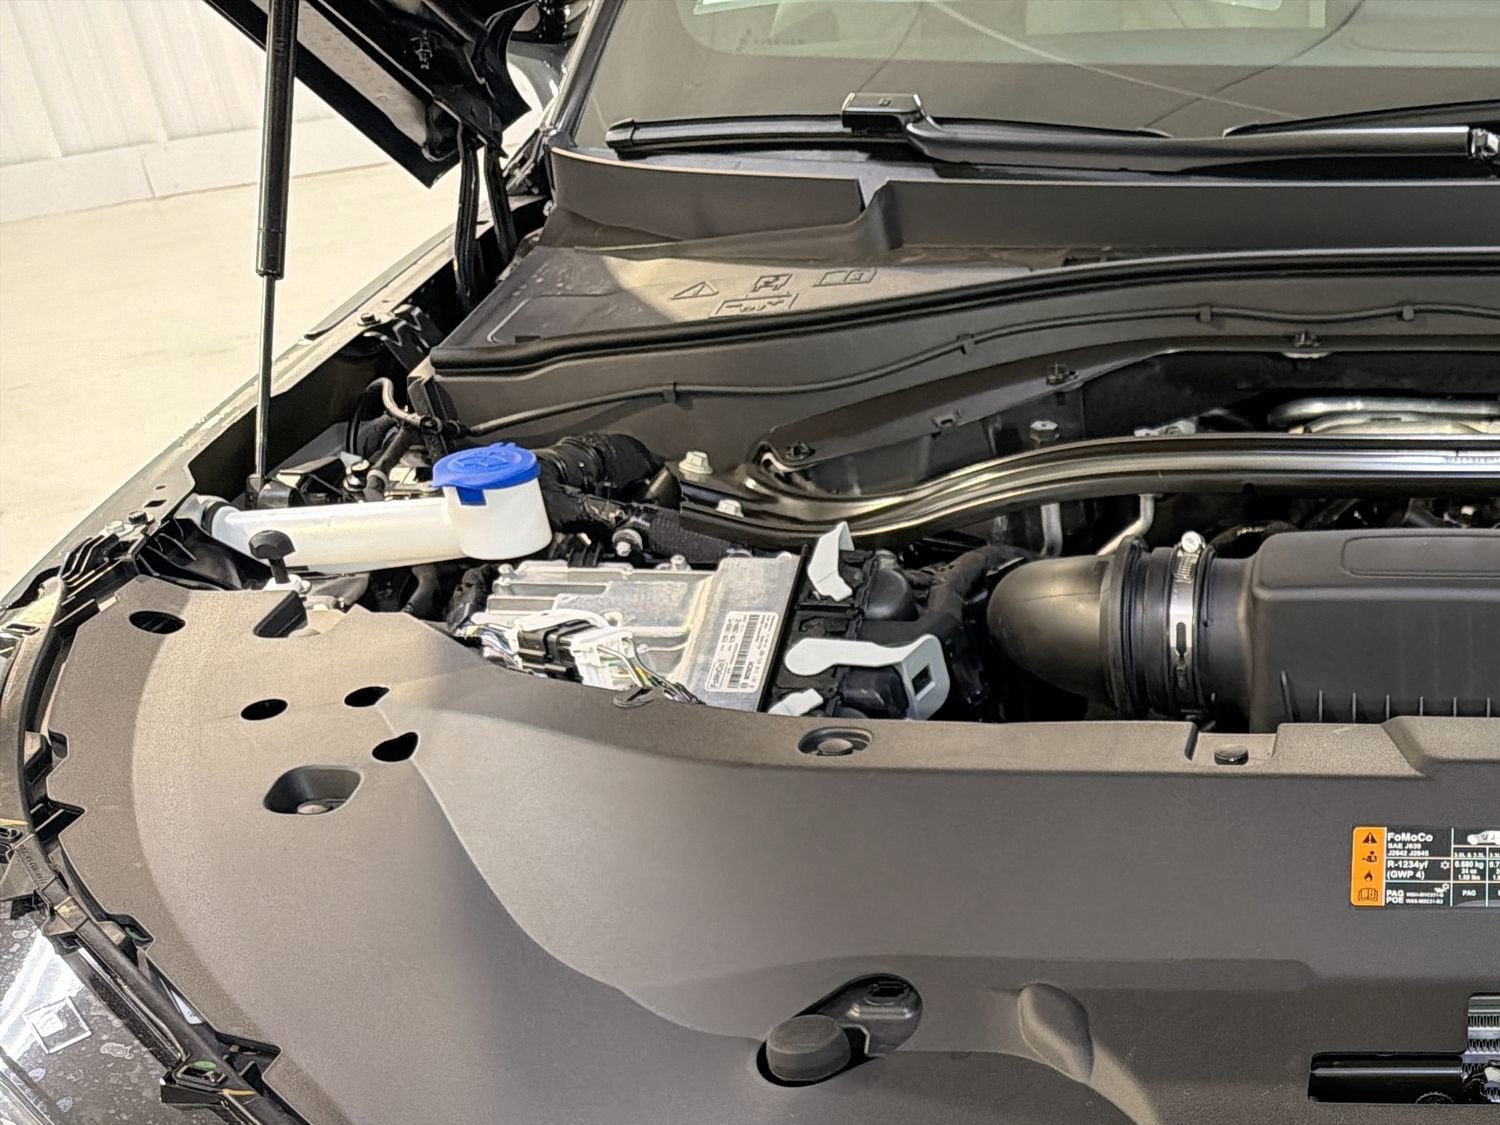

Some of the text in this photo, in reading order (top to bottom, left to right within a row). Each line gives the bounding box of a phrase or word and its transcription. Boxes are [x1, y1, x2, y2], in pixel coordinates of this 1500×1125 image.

[1388, 832, 1433, 842] FoMoCo
[1387, 861, 1429, 870] R-1234yf
[1475, 861, 1484, 869] kg
[1387, 870, 1425, 880] (GWP 4)
